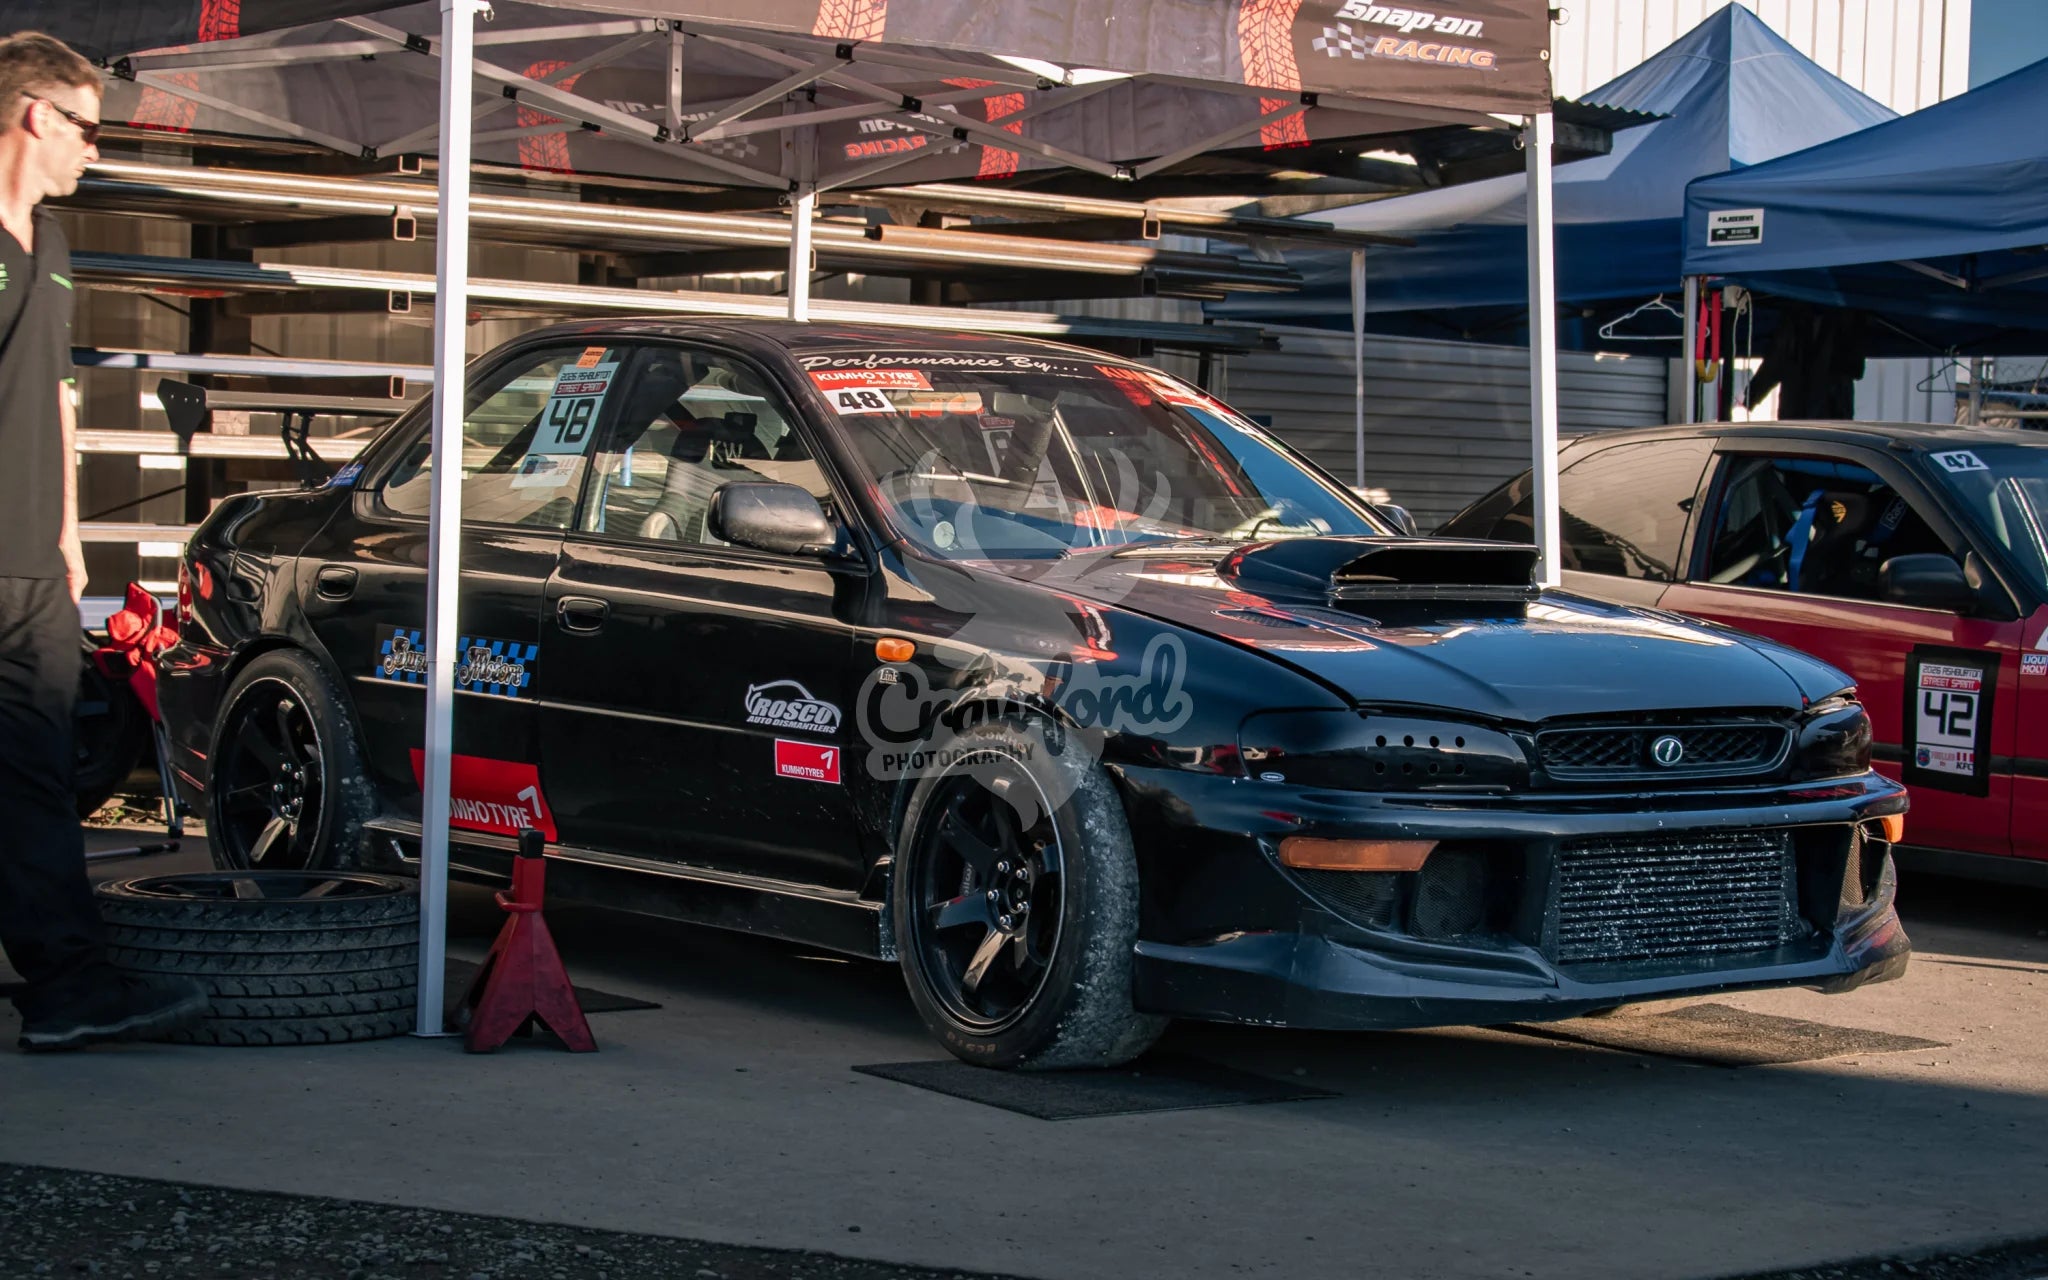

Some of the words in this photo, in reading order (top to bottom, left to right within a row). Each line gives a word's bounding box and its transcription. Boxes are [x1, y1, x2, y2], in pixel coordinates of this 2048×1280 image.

[1334, 0, 1483, 37] Snap-on
[1374, 36, 1496, 68] RACING
[799, 354, 1002, 370] Performance
[816, 371, 875, 382] KUMHO
[879, 371, 915, 381] TYRE
[557, 383, 581, 393] STREET
[581, 382, 603, 392] SPRINT
[838, 391, 885, 410] 48
[549, 398, 596, 444] 48
[1943, 453, 1981, 469] 42
[2023, 655, 2047, 665] LIQUI
[2021, 664, 2045, 674] MOLY
[1922, 675, 1949, 687] STREET
[1951, 678, 1976, 689] SPRINT
[752, 698, 833, 724] ROSCO
[1924, 691, 1974, 738] 42
[746, 715, 773, 725] AUTO
[772, 718, 837, 734] DISMANTLERS
